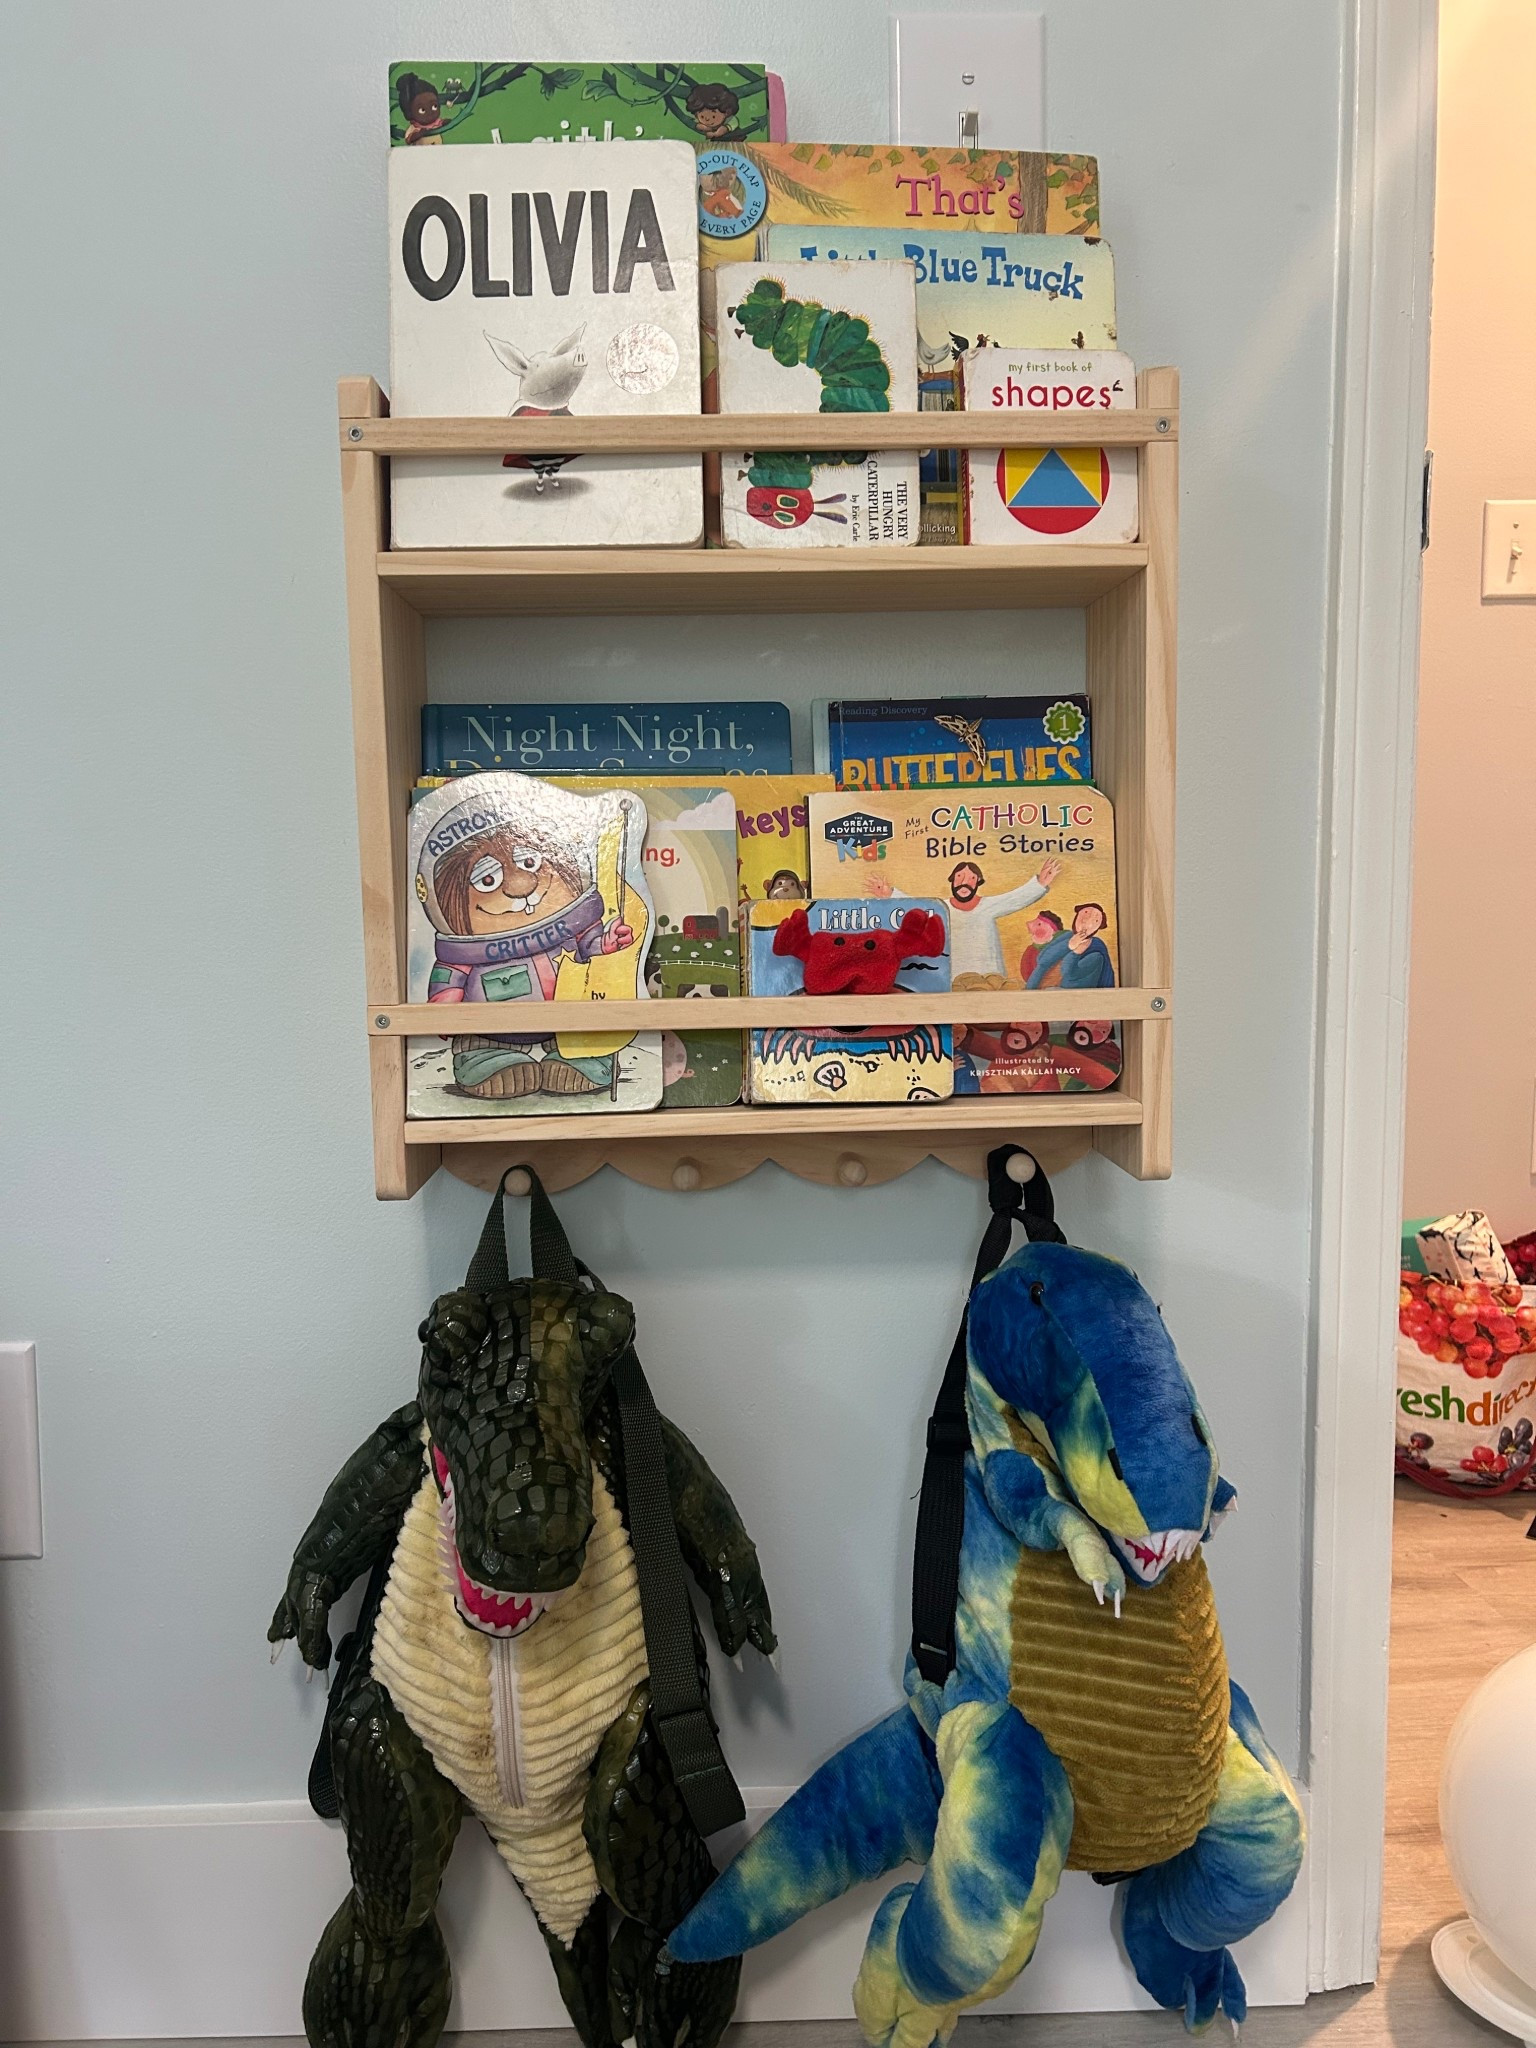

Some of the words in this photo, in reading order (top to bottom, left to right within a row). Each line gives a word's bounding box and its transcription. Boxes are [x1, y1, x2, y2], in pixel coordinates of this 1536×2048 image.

[739, 163, 760, 188] FLAP
[896, 174, 1025, 218] That's
[700, 218, 736, 235] EVERY
[740, 200, 762, 228] PAGE
[401, 188, 677, 302] OLIVIA
[903, 244, 978, 284] Blue
[981, 246, 1084, 300] Truck
[1008, 363, 1023, 375] my
[1026, 361, 1051, 373] first
[1054, 361, 1078, 373] book
[1081, 361, 1093, 373] of
[991, 376, 1112, 410] shapes
[850, 494, 860, 504] by
[867, 460, 880, 541] CATERPILLAR
[896, 481, 908, 507] THE
[851, 505, 860, 521] Eric
[882, 490, 894, 540] HUNGRY
[897, 508, 908, 540] VERY
[852, 522, 861, 542] Carle
[839, 706, 879, 717] Reading
[881, 705, 928, 716] Discovery
[1059, 713, 1070, 731] 1
[462, 715, 598, 765] Night
[611, 714, 754, 764] Night,
[905, 817, 921, 828] My
[931, 803, 1093, 831] CATHOLIC
[830, 826, 888, 834] ADVENTURE
[905, 826, 929, 840] First
[837, 838, 887, 862] Kids
[926, 836, 987, 858] Bible
[1000, 832, 1095, 854] Stories
[818, 906, 881, 931] Little
[485, 919, 573, 960] CRITTER
[970, 1069, 1019, 1077] KRISZTINA
[1055, 1067, 1081, 1075] NAGY
[1044, 1056, 1055, 1064] by
[1397, 1378, 1536, 1427] eshdirect
